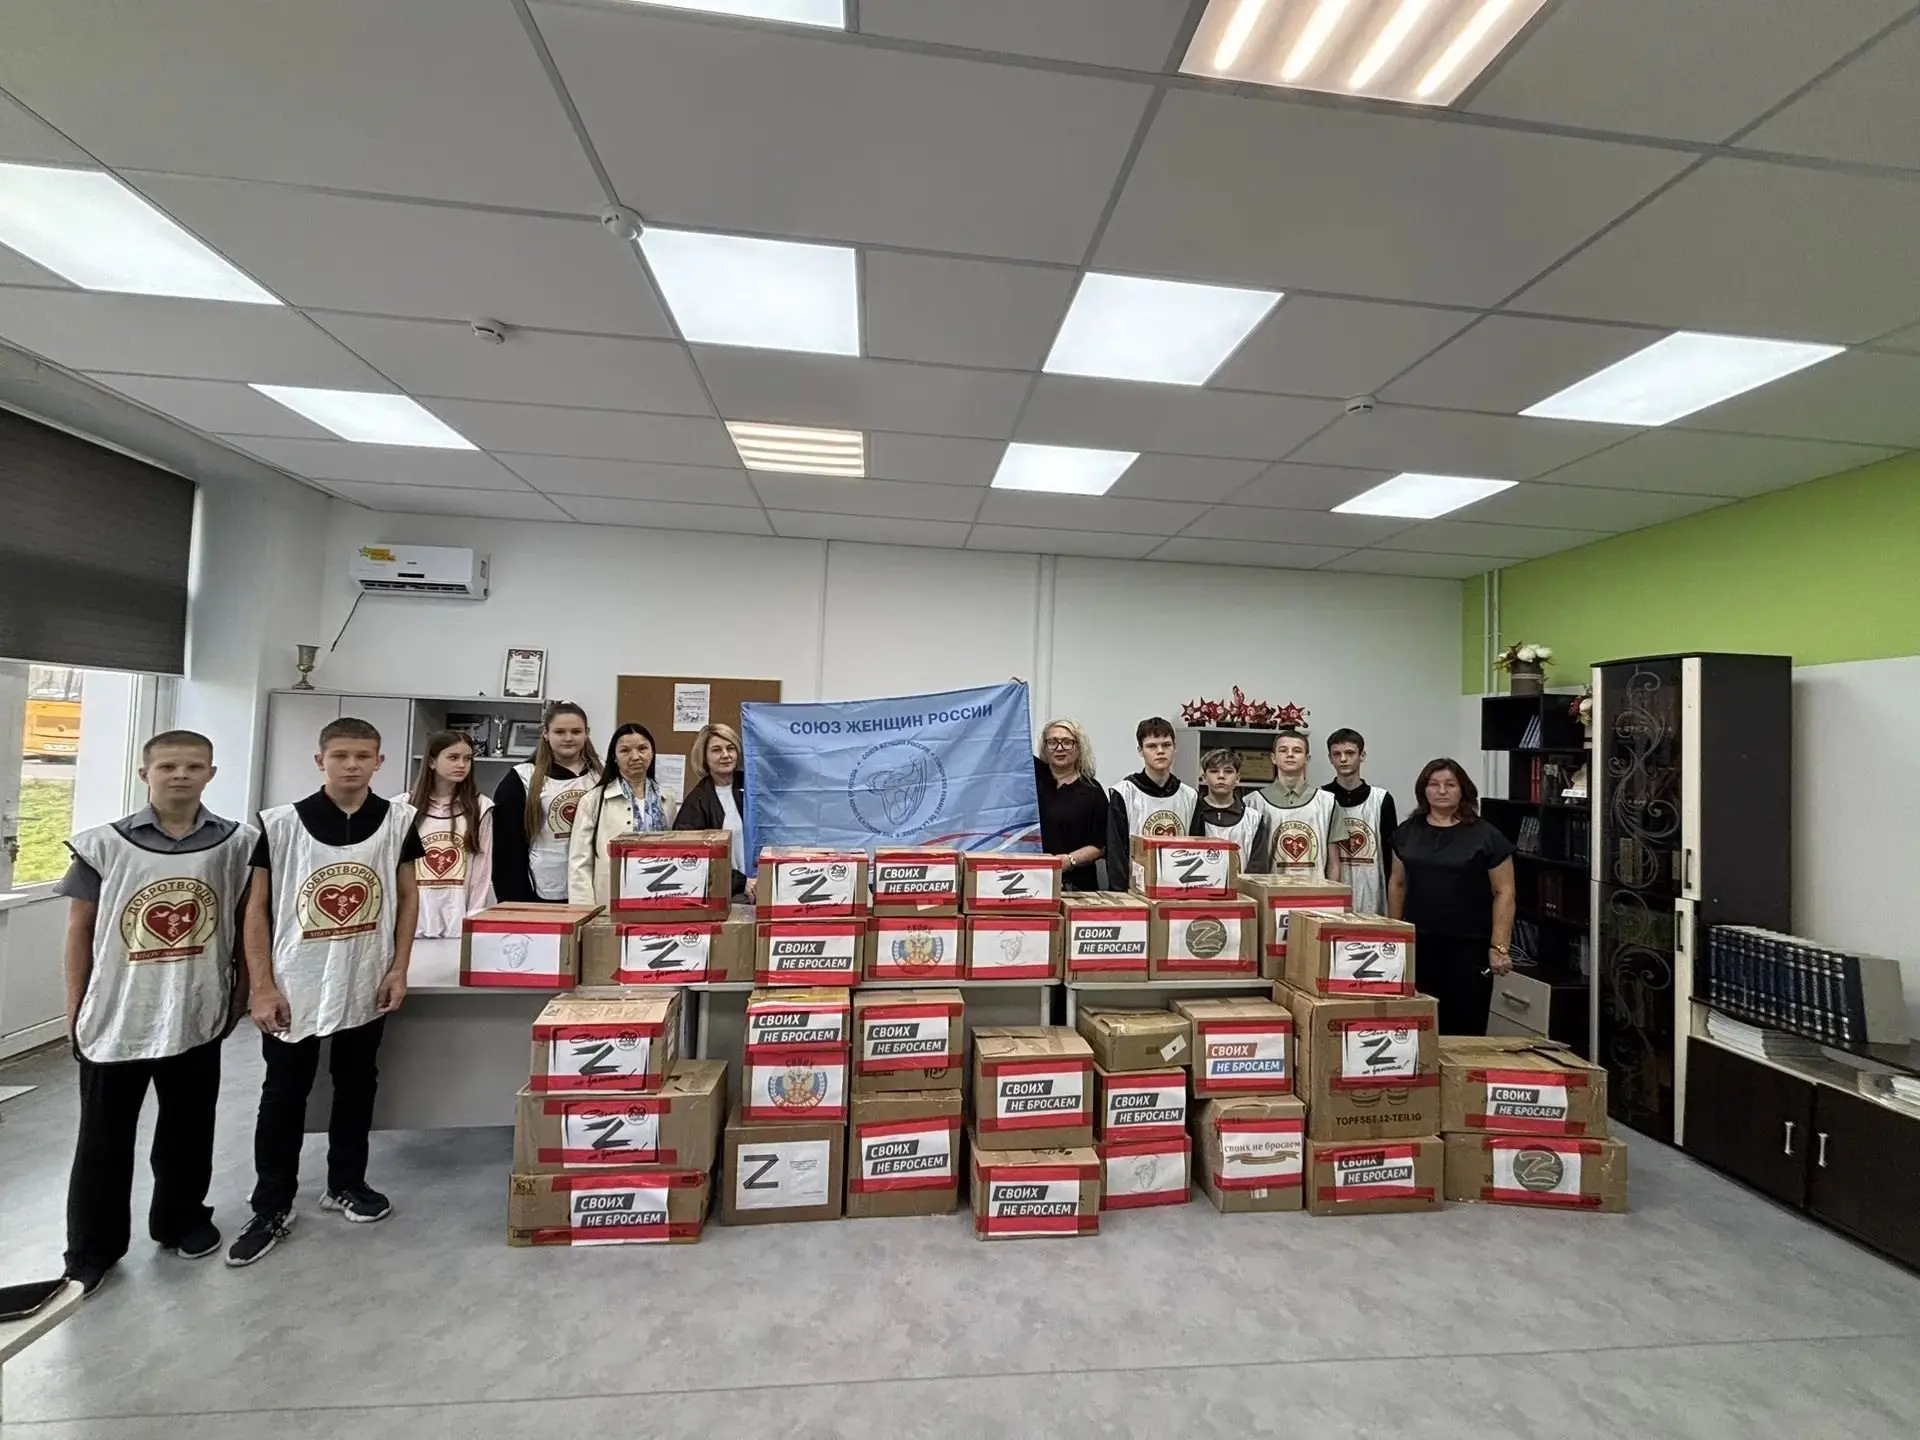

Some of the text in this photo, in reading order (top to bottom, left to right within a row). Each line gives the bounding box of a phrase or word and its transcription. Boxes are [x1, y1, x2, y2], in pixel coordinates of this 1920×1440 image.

[790, 704, 993, 734] СОЮЗ ЖЕНЩИН РОССИИ
[860, 744, 878, 760] СОЮЗ
[884, 868, 920, 879] СВОИХ
[1173, 856, 1209, 884] Z
[302, 866, 377, 898] ДОБРОТВОРЦЫ
[639, 863, 684, 892] Z
[997, 872, 1030, 896] Z
[790, 874, 833, 904] Z
[889, 882, 950, 894] НЕ БРОСАЕМ
[128, 882, 216, 916] ДОБРОТВОРЦЫ
[1078, 928, 1112, 939] СВОИХ
[778, 943, 816, 954] СВОИХ
[1083, 943, 1141, 952] НЕ БРОСАЕМ
[641, 940, 686, 970] Z
[782, 958, 847, 969] НЕ БРОСАЕМ
[1346, 950, 1385, 979] Z
[758, 1014, 800, 1026] СВОИХ
[764, 1030, 834, 1042] НЕ БРОСАЕМ
[872, 1026, 910, 1038] СВОИХ
[876, 1041, 942, 1054] НЕ БРОСАЕМ
[1212, 1045, 1249, 1057] СВОИХ
[1360, 1036, 1398, 1066] Z
[571, 1042, 622, 1076] Z
[1216, 1060, 1280, 1072] НЕ БРОСАЕМ
[1006, 1083, 1044, 1095] СВОИХ
[1115, 1095, 1150, 1108] СВОИХ
[1496, 1090, 1532, 1102] СВОИХ
[1011, 1098, 1076, 1111] НЕ БРОСАЕМ
[1499, 1105, 1561, 1117] НЕ БРОСАЕМ
[1120, 1110, 1179, 1122] НЕ БРОСАЕМ
[582, 1117, 633, 1150] Z
[871, 1143, 910, 1158] СВОИХ
[1252, 1143, 1264, 1151] не
[1264, 1141, 1301, 1152] бросаем
[876, 1156, 943, 1173] НЕ БРОСАЕМ
[1342, 1154, 1377, 1168] СВОИХ
[742, 1154, 779, 1190] Z
[1348, 1168, 1408, 1184] НЕ БРОСАЕМ
[999, 1188, 1039, 1199] СВОИХ
[580, 1196, 624, 1210] СВОИХ
[1003, 1204, 1071, 1216] НЕ БРОСАЕМ
[587, 1212, 661, 1226] НЕ БРОСАЕМ
